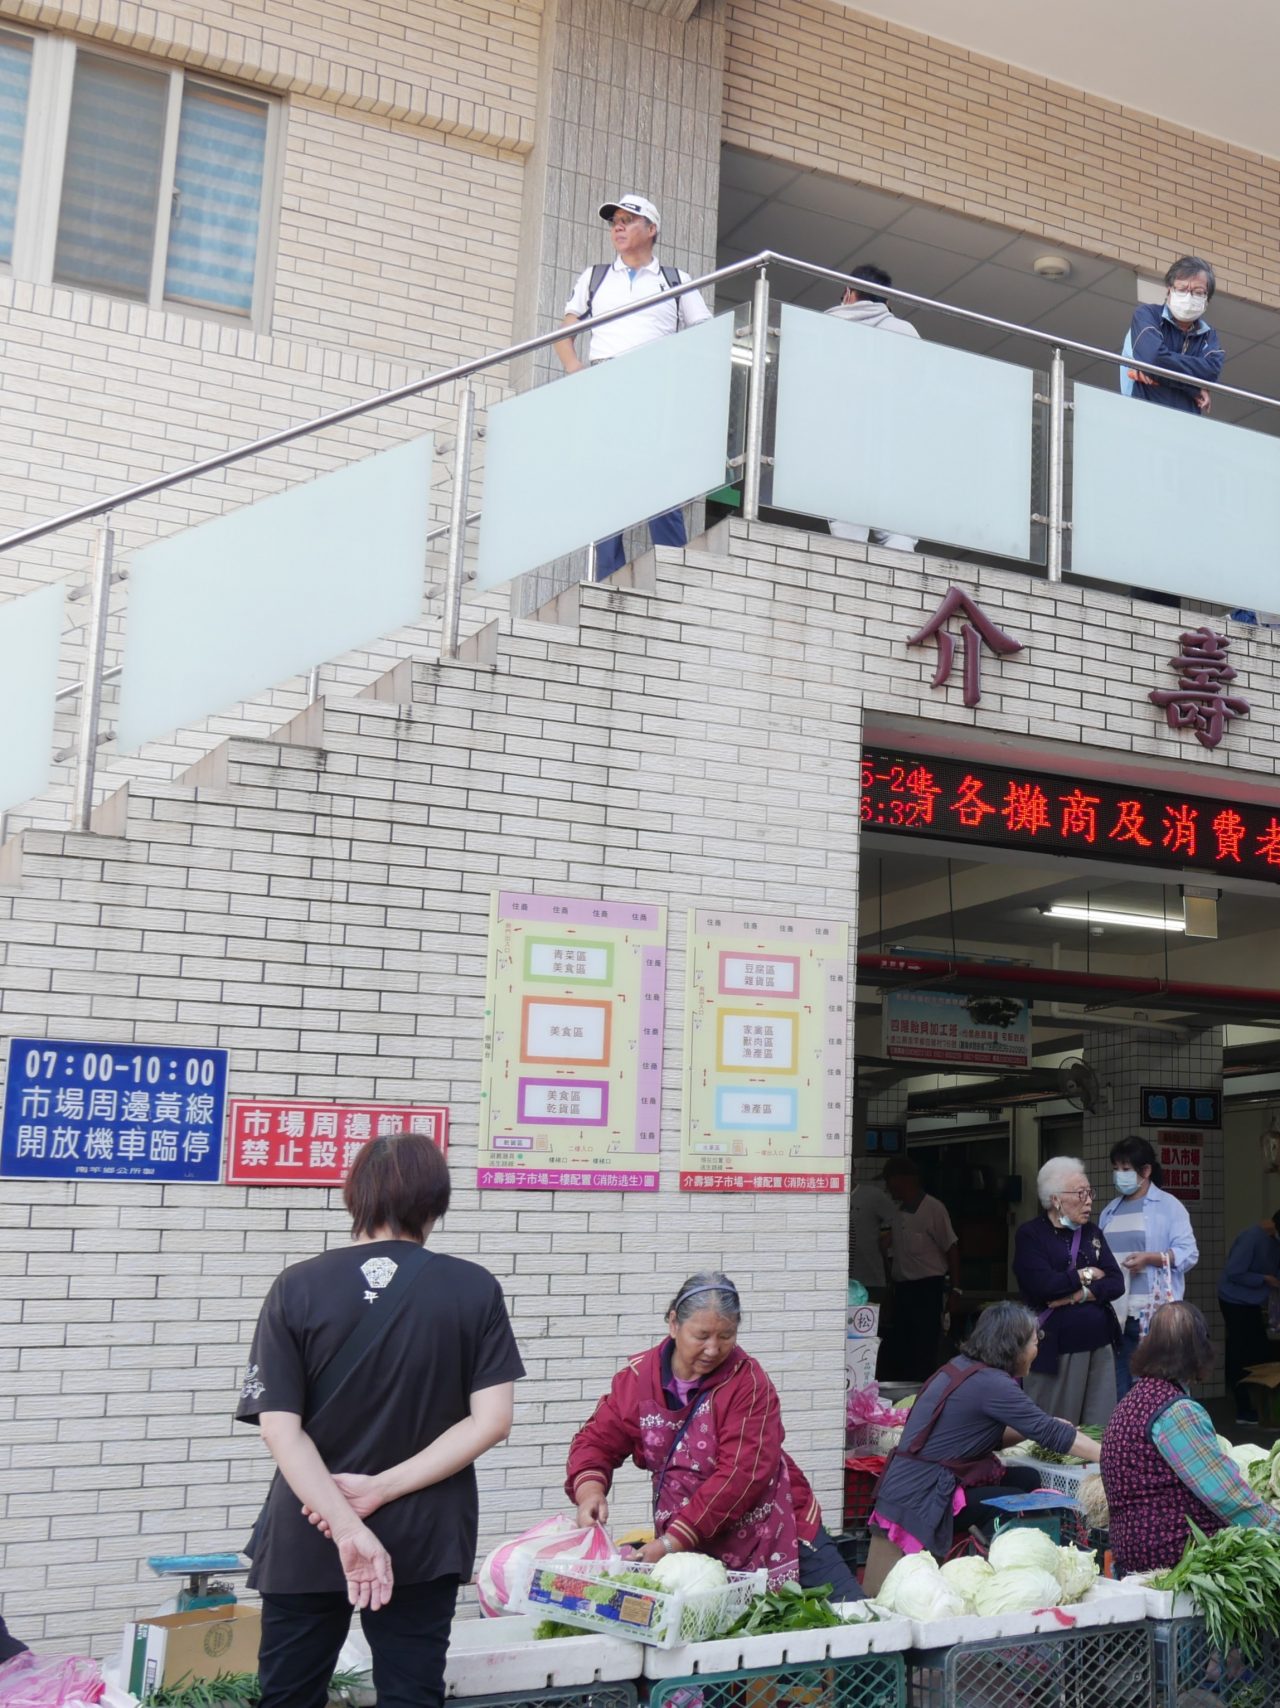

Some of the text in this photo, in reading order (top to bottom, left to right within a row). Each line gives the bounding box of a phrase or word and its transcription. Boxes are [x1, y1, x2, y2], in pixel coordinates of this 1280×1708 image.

[554, 949, 587, 962] 青菜區
[552, 962, 586, 975] 美食區
[550, 1026, 584, 1038] 美食區
[25, 1050, 215, 1087] 07:00-10:00
[547, 1090, 581, 1102] 美食區
[21, 1085, 214, 1125] 市場周邊黃線
[546, 1103, 580, 1115] 乾貨區
[742, 1104, 772, 1114] 漁產區
[243, 1109, 436, 1140] 市場周邊範圍
[17, 1125, 210, 1163] 開放機車臨停
[482, 1172, 655, 1187] 介壽獅子市場二樓配置(消防逃生)圖
[684, 1176, 840, 1189] 介壽獅子市場一樓配置(消防逃生)圖
[858, 1313, 871, 1328] 松
